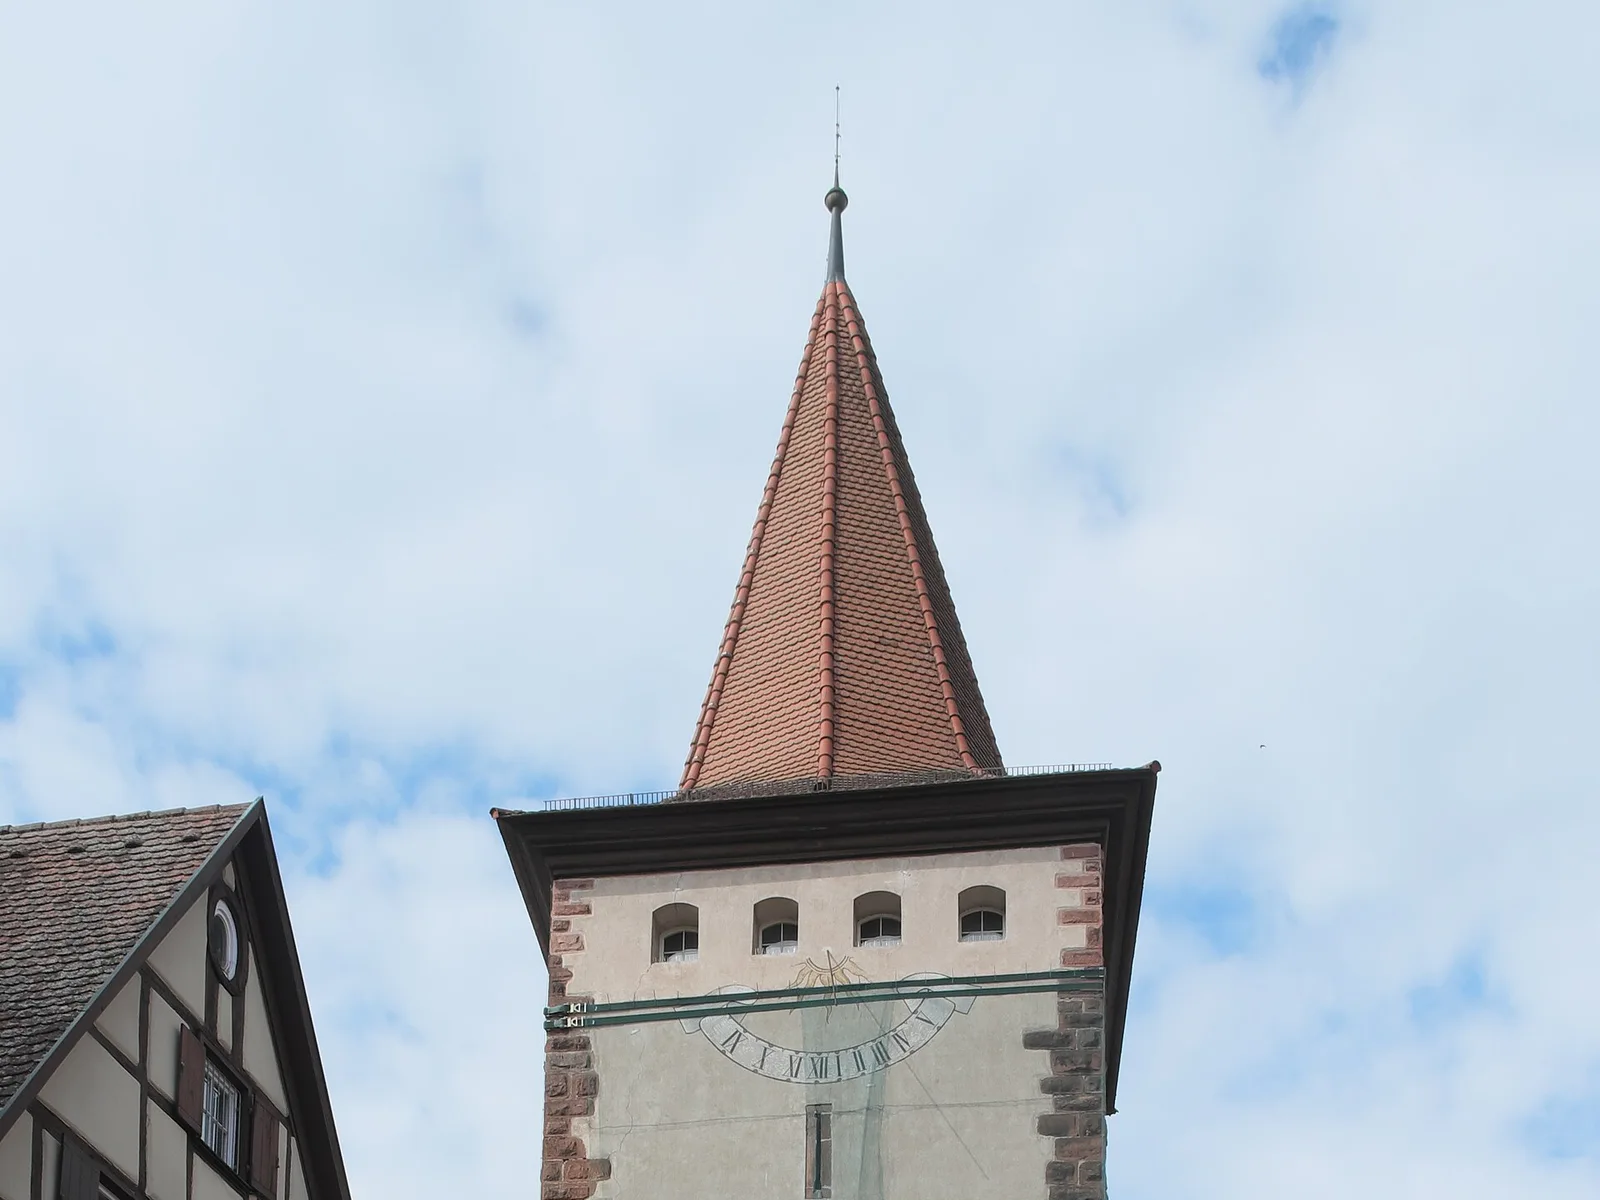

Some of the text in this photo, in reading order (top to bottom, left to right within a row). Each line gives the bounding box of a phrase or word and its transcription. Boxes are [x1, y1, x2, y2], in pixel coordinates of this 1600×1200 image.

[721, 1029, 748, 1054] IX
[753, 1046, 775, 1070] X
[782, 1055, 803, 1078] XI
[807, 1057, 828, 1079] XII
[853, 1050, 866, 1072] II
[871, 1041, 891, 1065] III
[892, 1030, 911, 1052] IV
[915, 1011, 935, 1026] V
